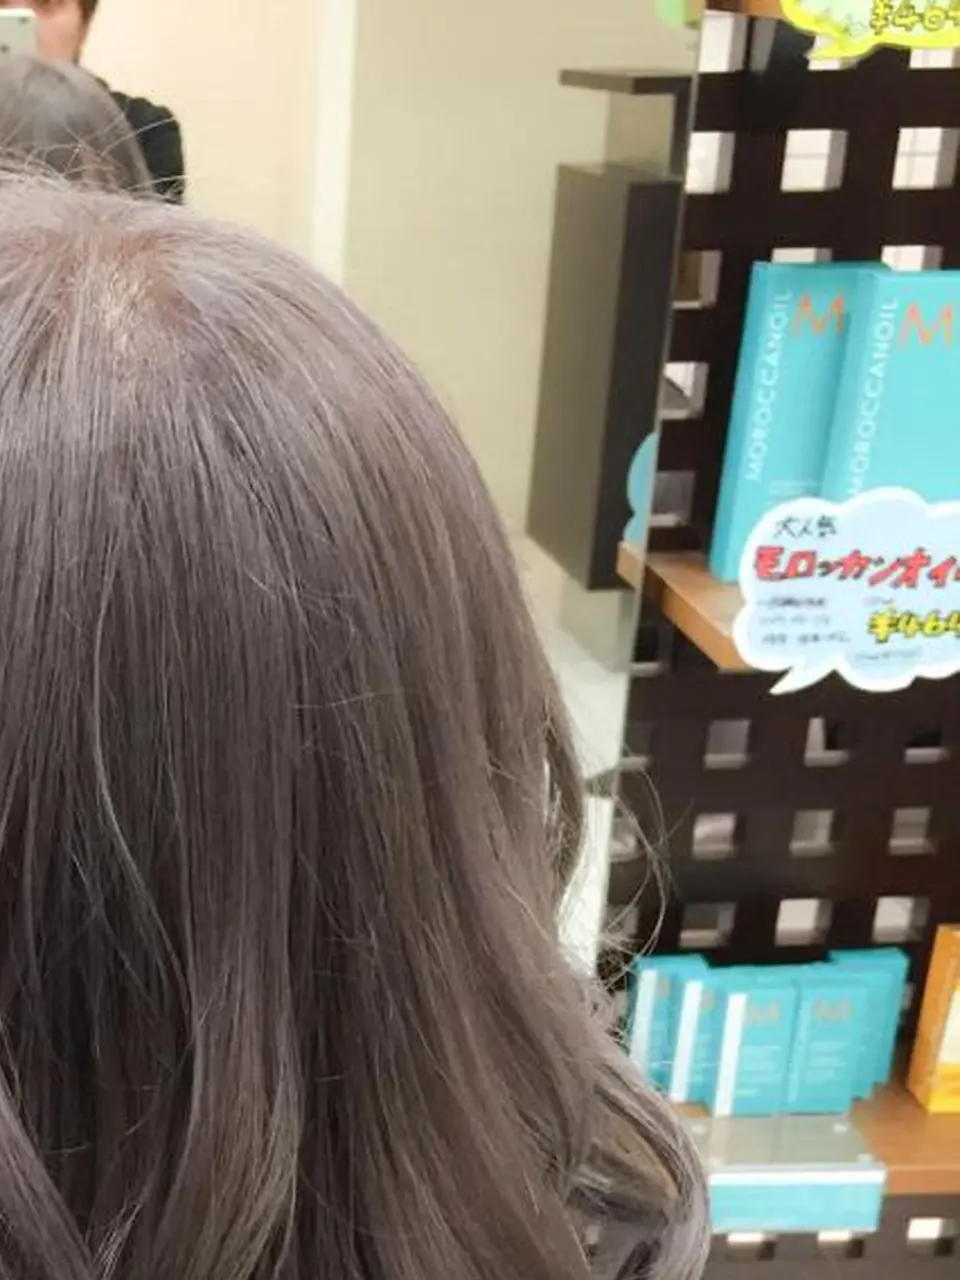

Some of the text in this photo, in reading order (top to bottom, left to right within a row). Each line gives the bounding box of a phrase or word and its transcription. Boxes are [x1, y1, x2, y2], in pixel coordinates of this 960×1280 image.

[744, 292, 792, 483] MOROCCANOIL
[754, 545, 960, 589] モロッカンオイ
